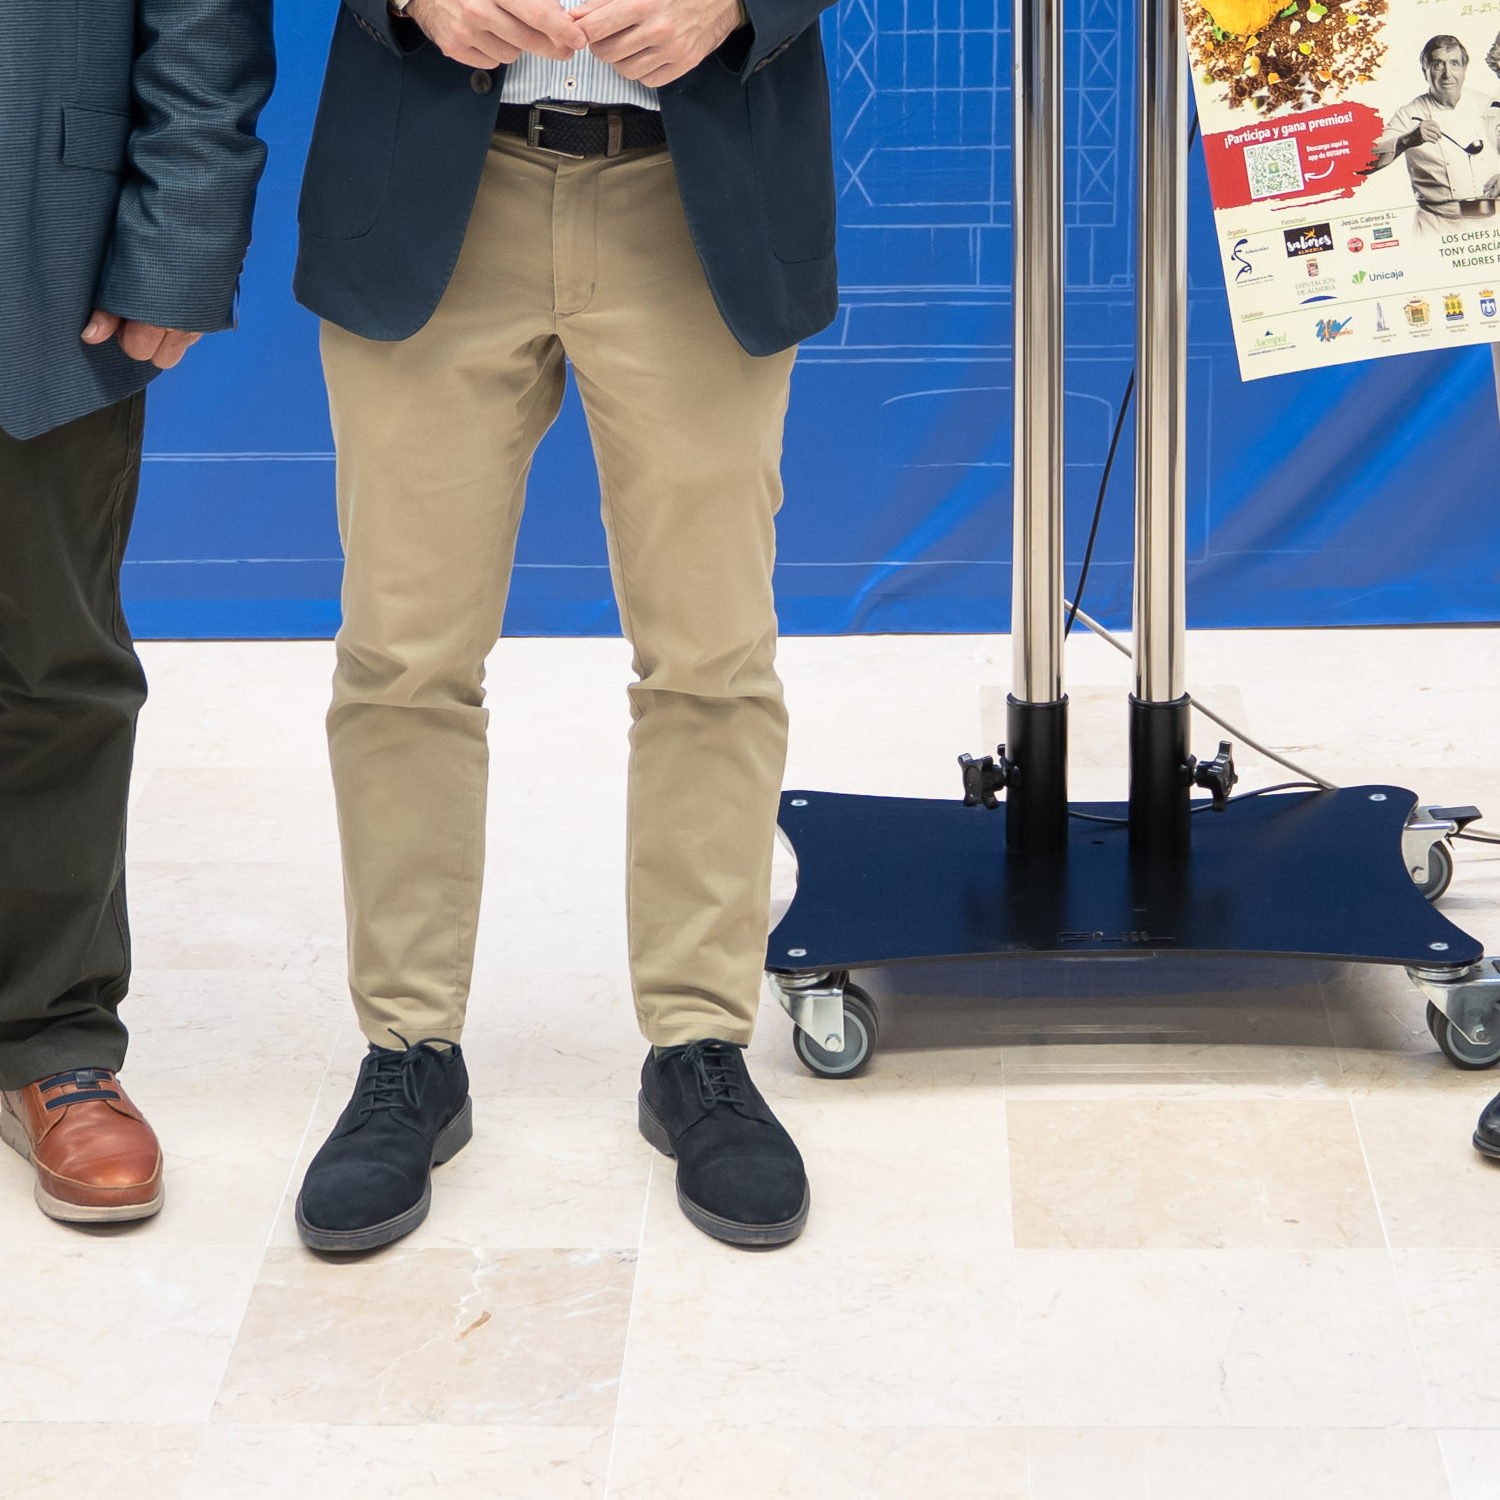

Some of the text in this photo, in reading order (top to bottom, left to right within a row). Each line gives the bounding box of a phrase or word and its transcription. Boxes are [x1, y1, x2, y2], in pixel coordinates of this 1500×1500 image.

[1224, 111, 1353, 148] ¡Participa y gana premios!
[1361, 214, 1385, 224] Cabrera
[1286, 234, 1332, 252] sabores
[1441, 234, 1459, 245] LOS
[1461, 230, 1490, 242] CHEFS
[1439, 246, 1465, 258] TONY
[1452, 255, 1495, 269] MEJORES
[1369, 269, 1404, 282] Unicaja
